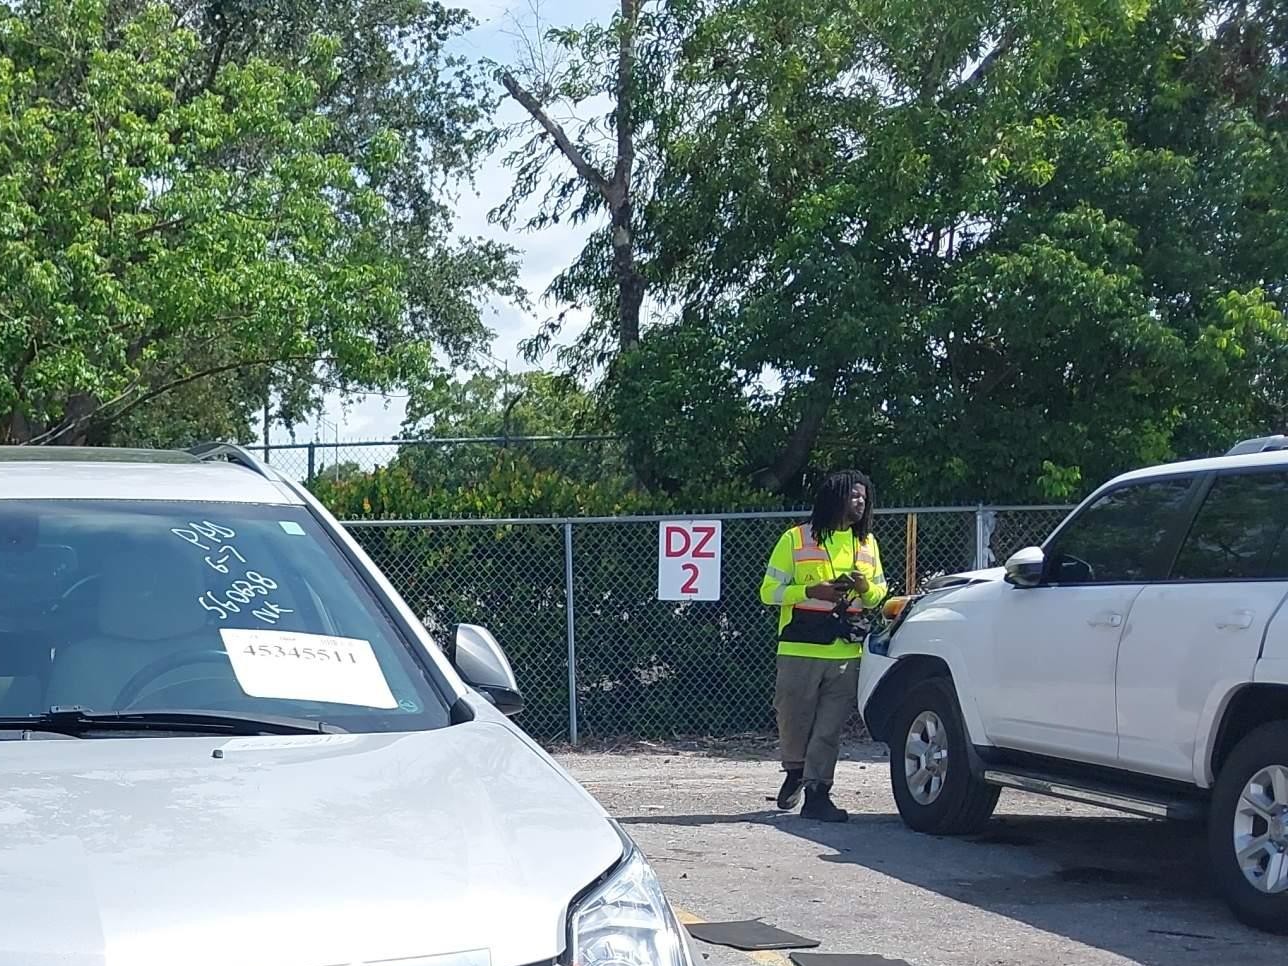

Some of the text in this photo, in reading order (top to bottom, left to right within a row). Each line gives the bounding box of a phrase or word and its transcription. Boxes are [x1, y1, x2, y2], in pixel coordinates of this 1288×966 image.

[665, 526, 716, 558] DZ
[680, 563, 699, 594] 2
[243, 645, 356, 664] 45345511
